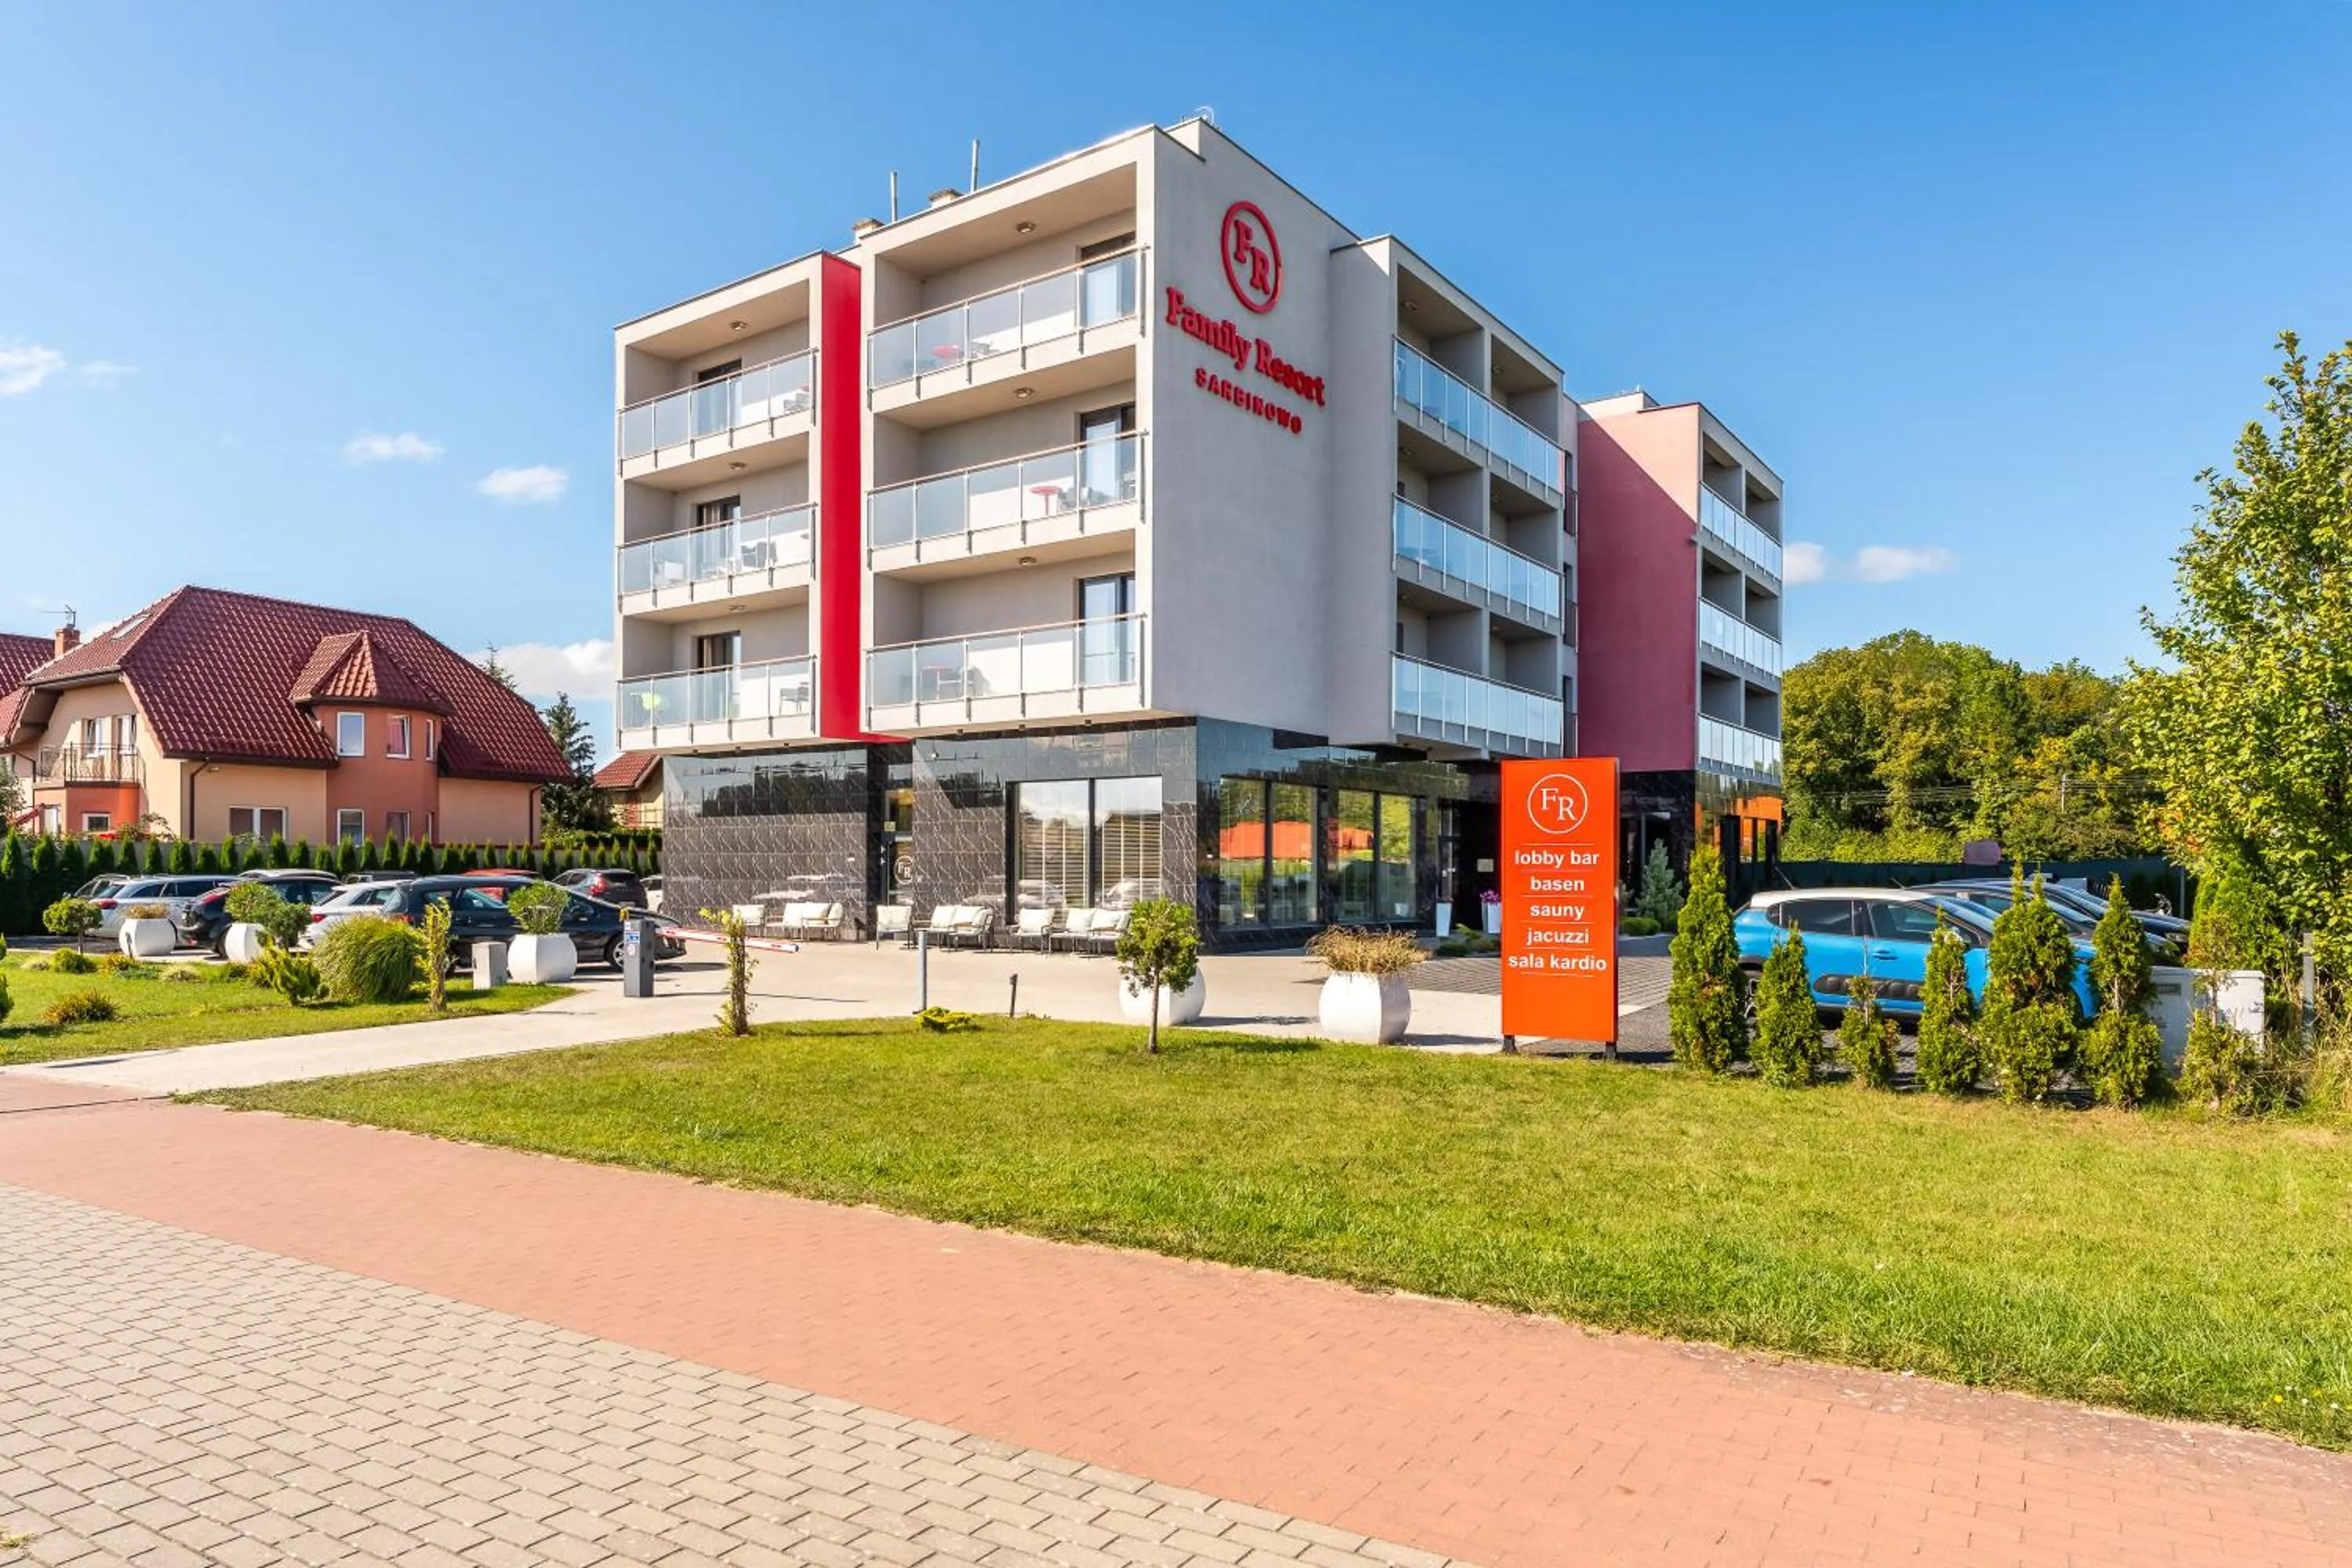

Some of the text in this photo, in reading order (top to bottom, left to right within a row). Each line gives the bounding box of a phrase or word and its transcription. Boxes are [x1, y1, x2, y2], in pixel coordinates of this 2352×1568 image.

[1234, 220, 1269, 295] FR
[1166, 286, 1326, 407] Family Resort
[1194, 367, 1303, 434] SARBINOWO
[1541, 787, 1575, 821] FR
[1514, 850, 1599, 869] lobby bar
[1530, 877, 1585, 891] basen
[1530, 905, 1585, 921] sauny
[1526, 930, 1590, 946] jacuzzi
[1508, 953, 1607, 971] sala kardio
